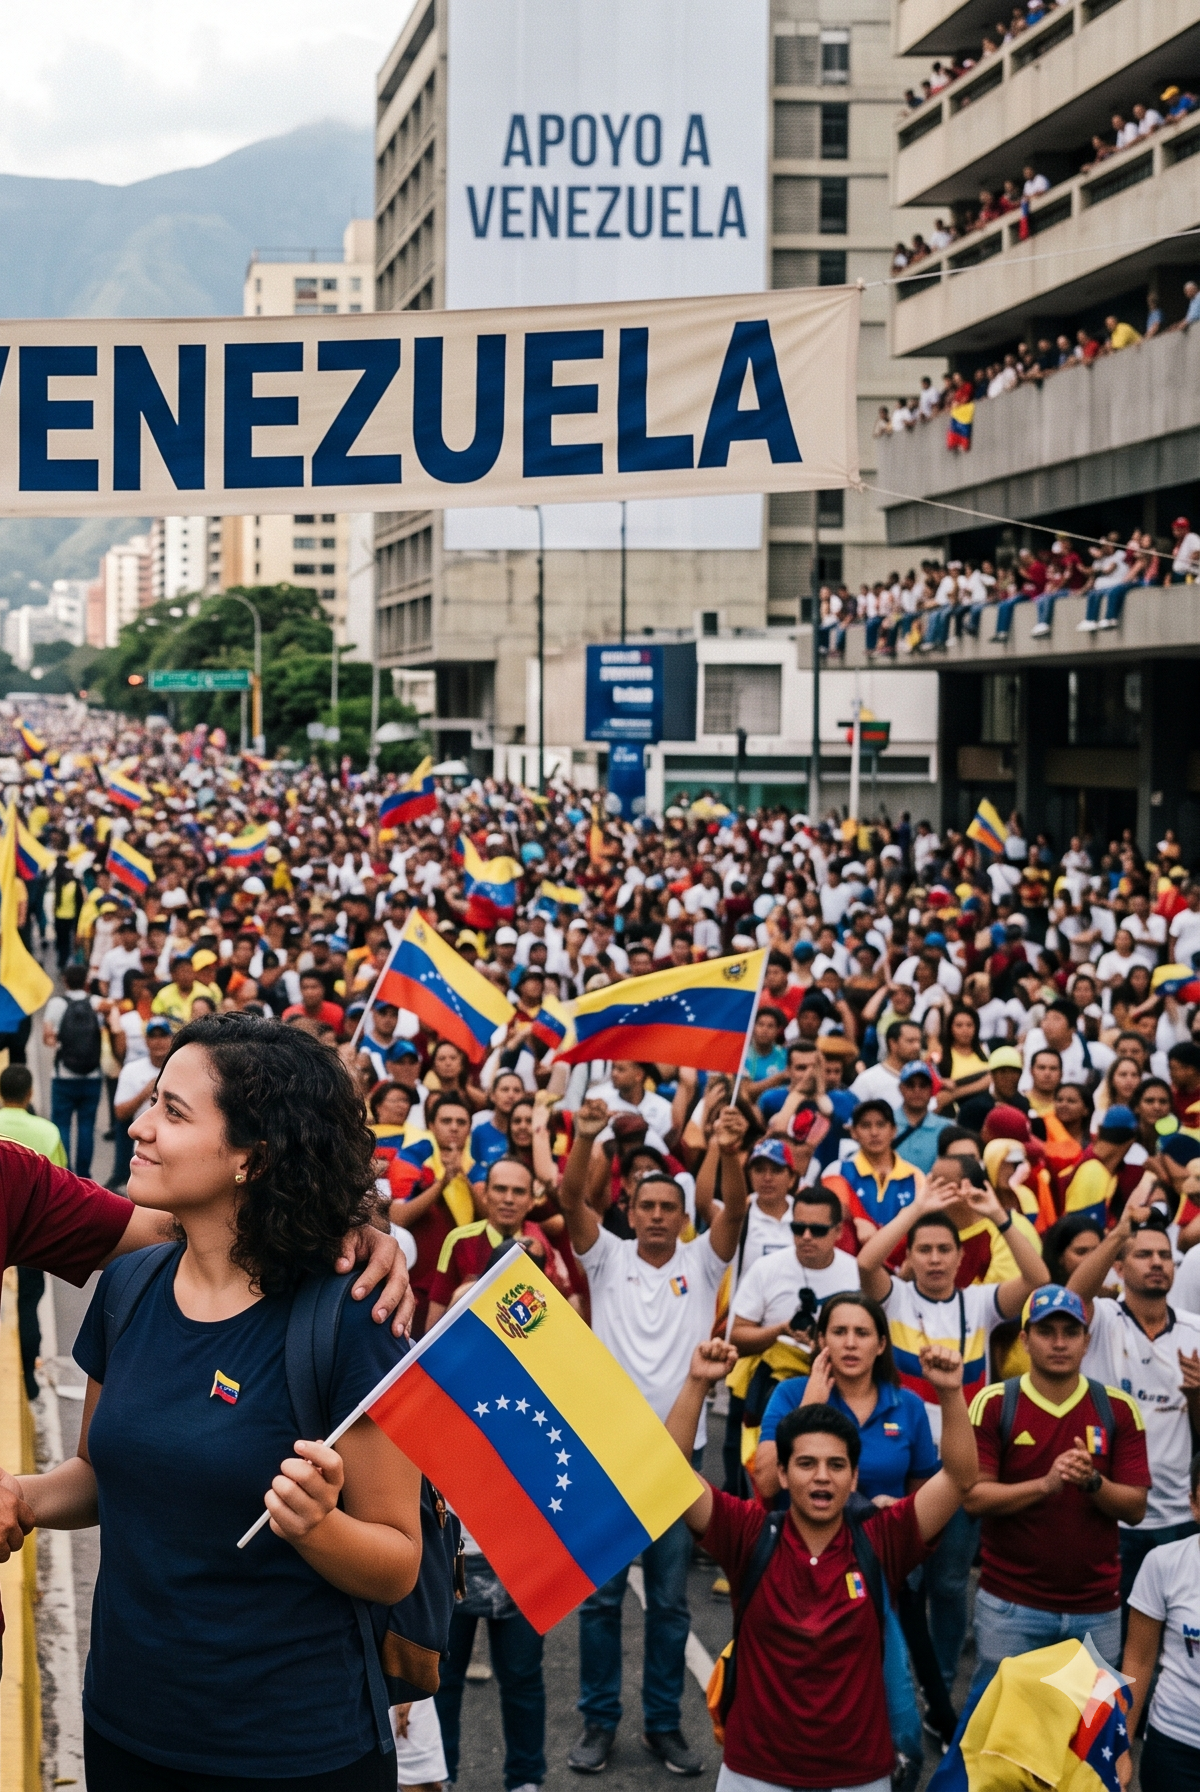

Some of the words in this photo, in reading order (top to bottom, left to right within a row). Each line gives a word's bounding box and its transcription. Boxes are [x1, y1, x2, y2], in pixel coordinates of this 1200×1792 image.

[503, 113, 663, 167] APOYO
[680, 113, 711, 167] A
[466, 185, 747, 240] VENEZUELA
